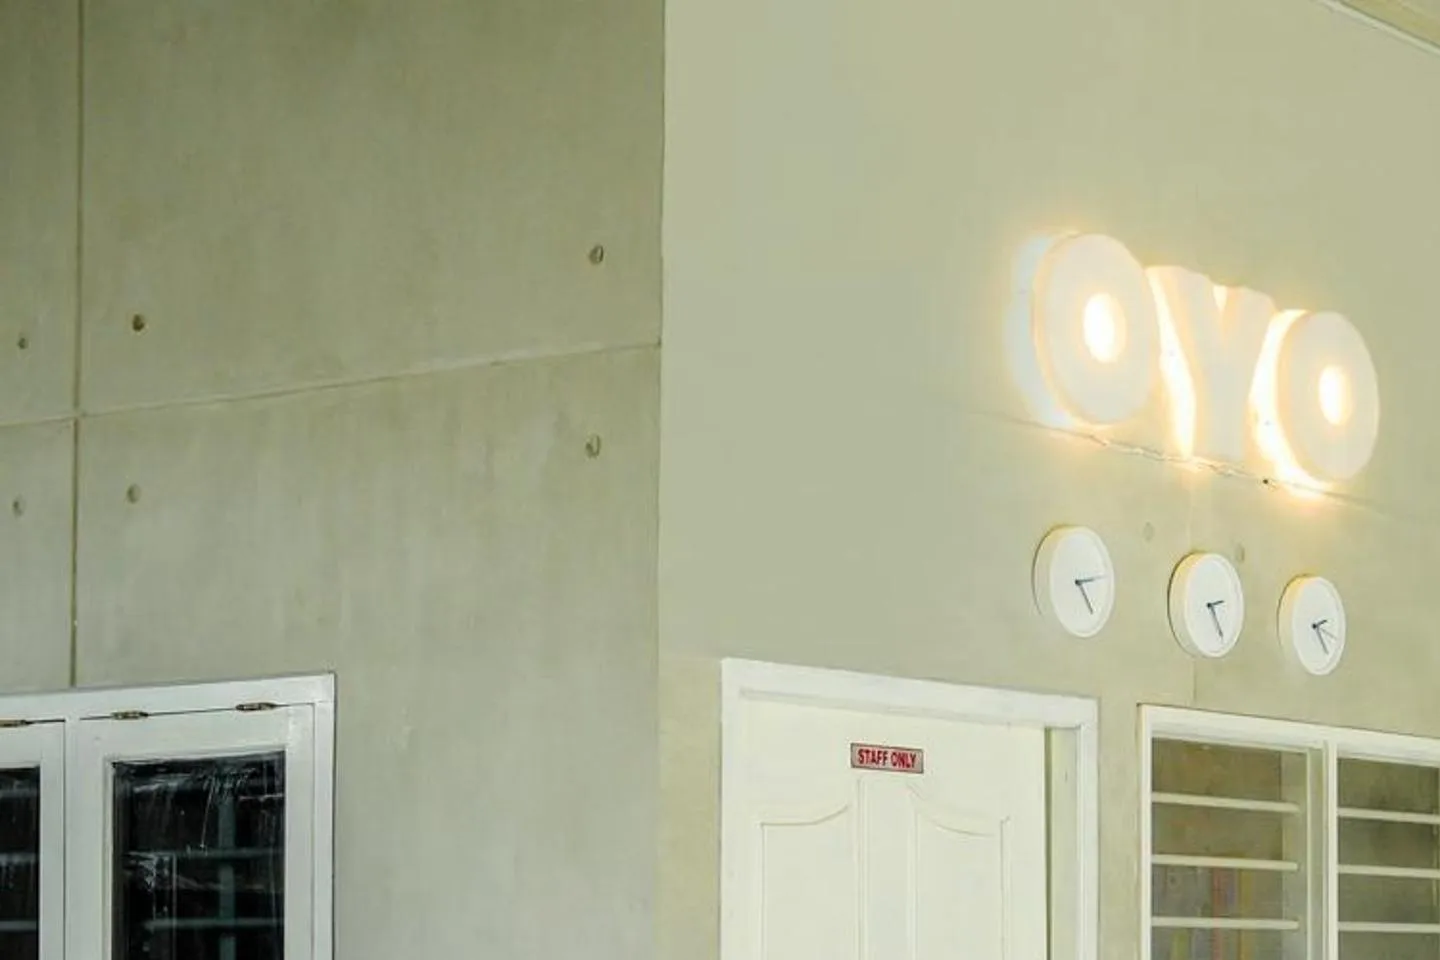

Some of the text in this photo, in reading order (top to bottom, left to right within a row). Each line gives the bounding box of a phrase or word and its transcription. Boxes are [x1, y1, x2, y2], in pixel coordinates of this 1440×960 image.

[1033, 232, 1380, 484] OYO
[857, 748, 917, 768] STAFF ONLY
